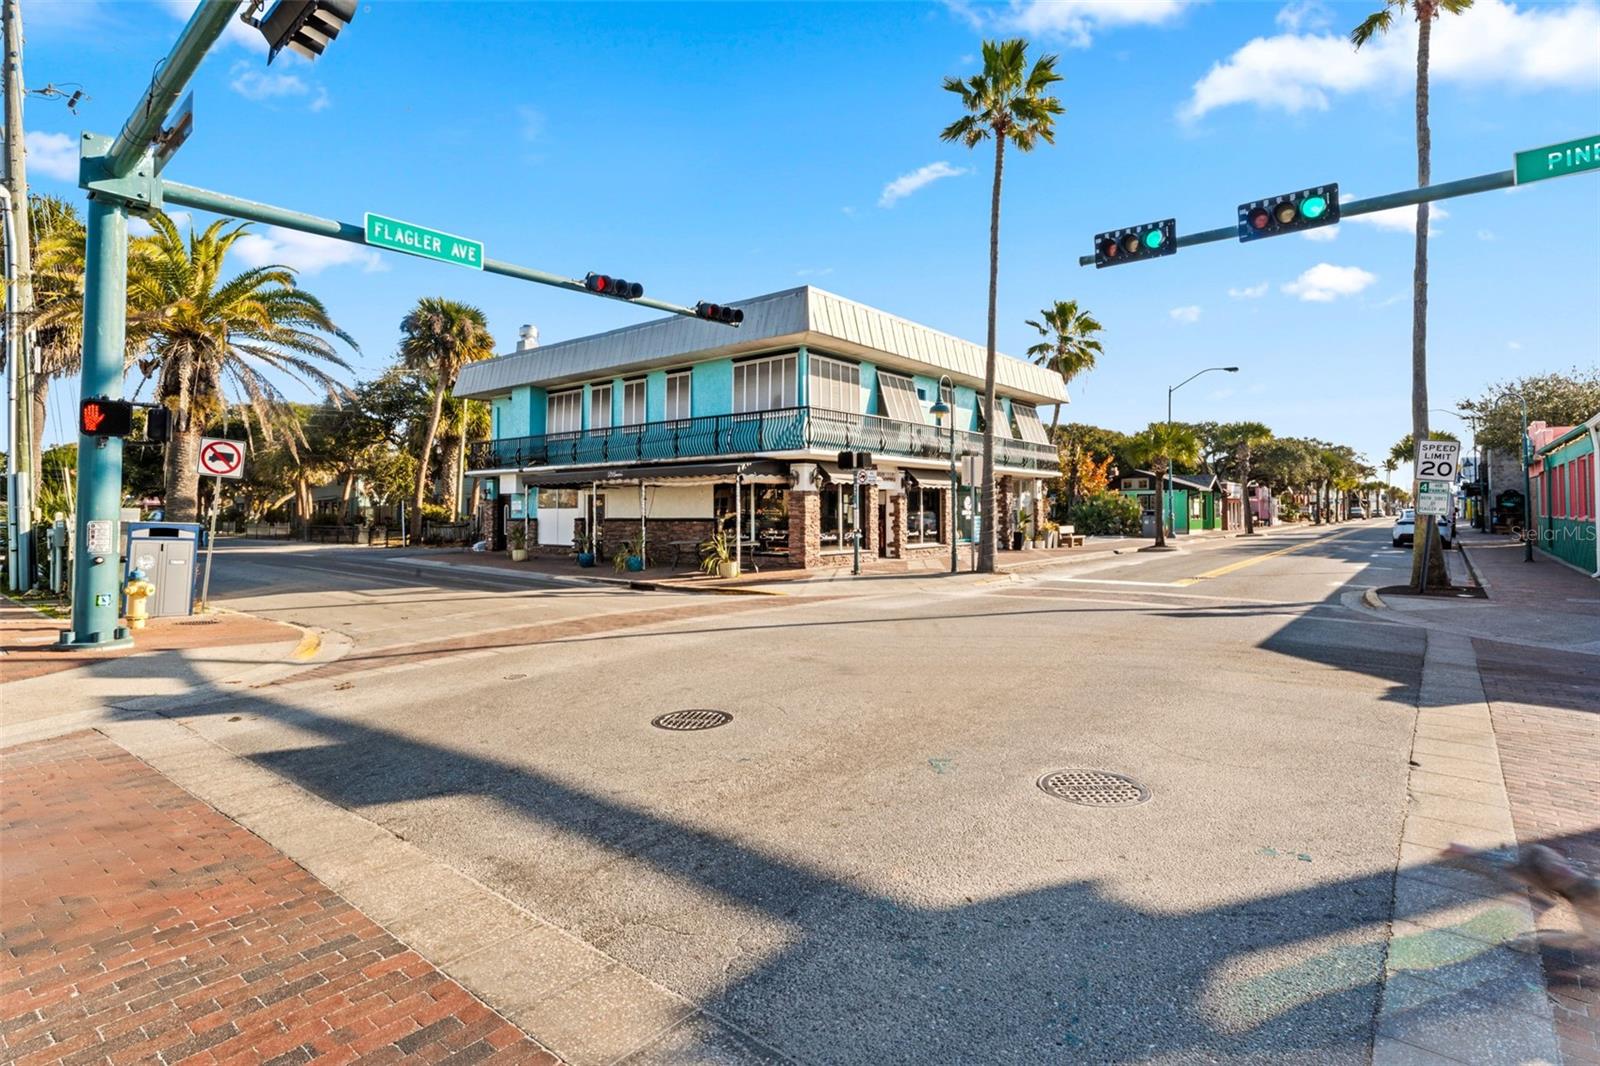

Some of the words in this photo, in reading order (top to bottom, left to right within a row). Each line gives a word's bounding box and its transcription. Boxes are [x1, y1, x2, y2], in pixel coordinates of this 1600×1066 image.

[374, 222, 441, 253] FLAGLER
[451, 243, 476, 261] AVE
[1422, 444, 1456, 452] SPEED
[1420, 461, 1453, 477] 20
[1421, 484, 1428, 492] 4
